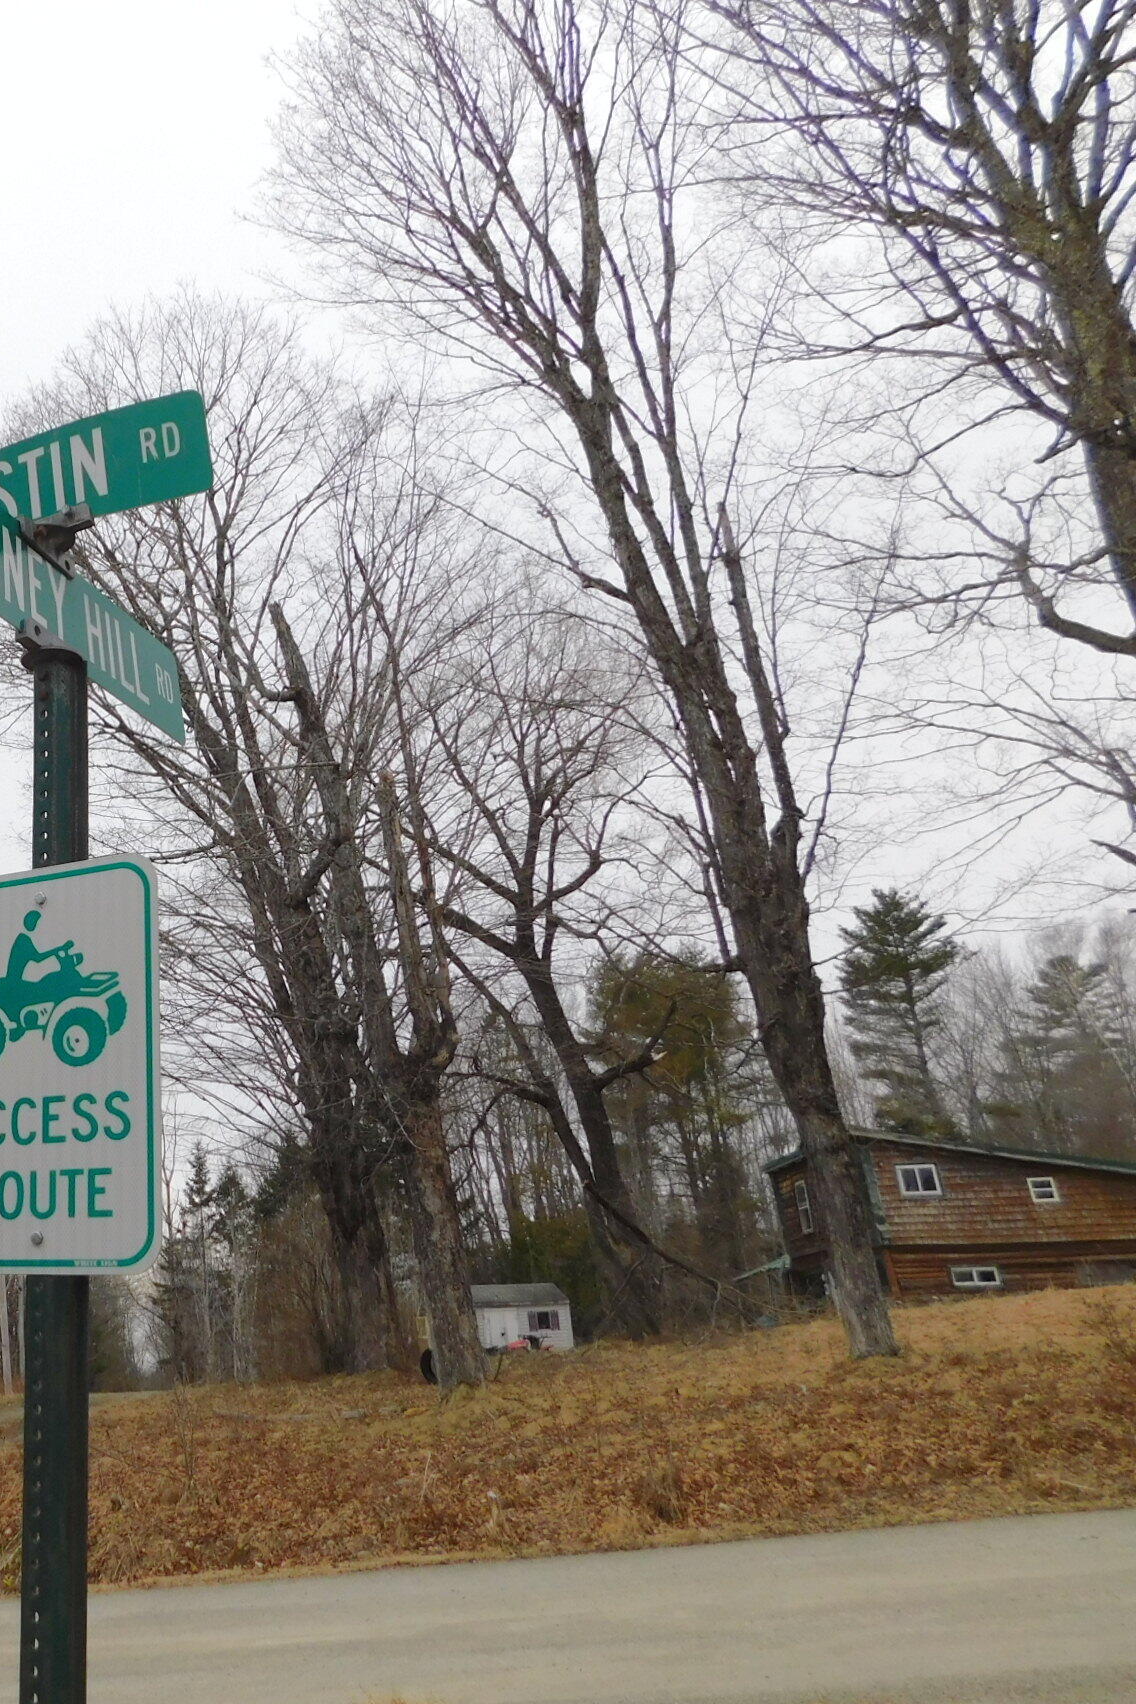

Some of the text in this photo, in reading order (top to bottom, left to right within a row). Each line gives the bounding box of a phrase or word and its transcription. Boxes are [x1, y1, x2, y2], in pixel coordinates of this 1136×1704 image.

[139, 422, 181, 464] RD
[84, 594, 149, 704] HILL
[155, 663, 174, 704] RD
